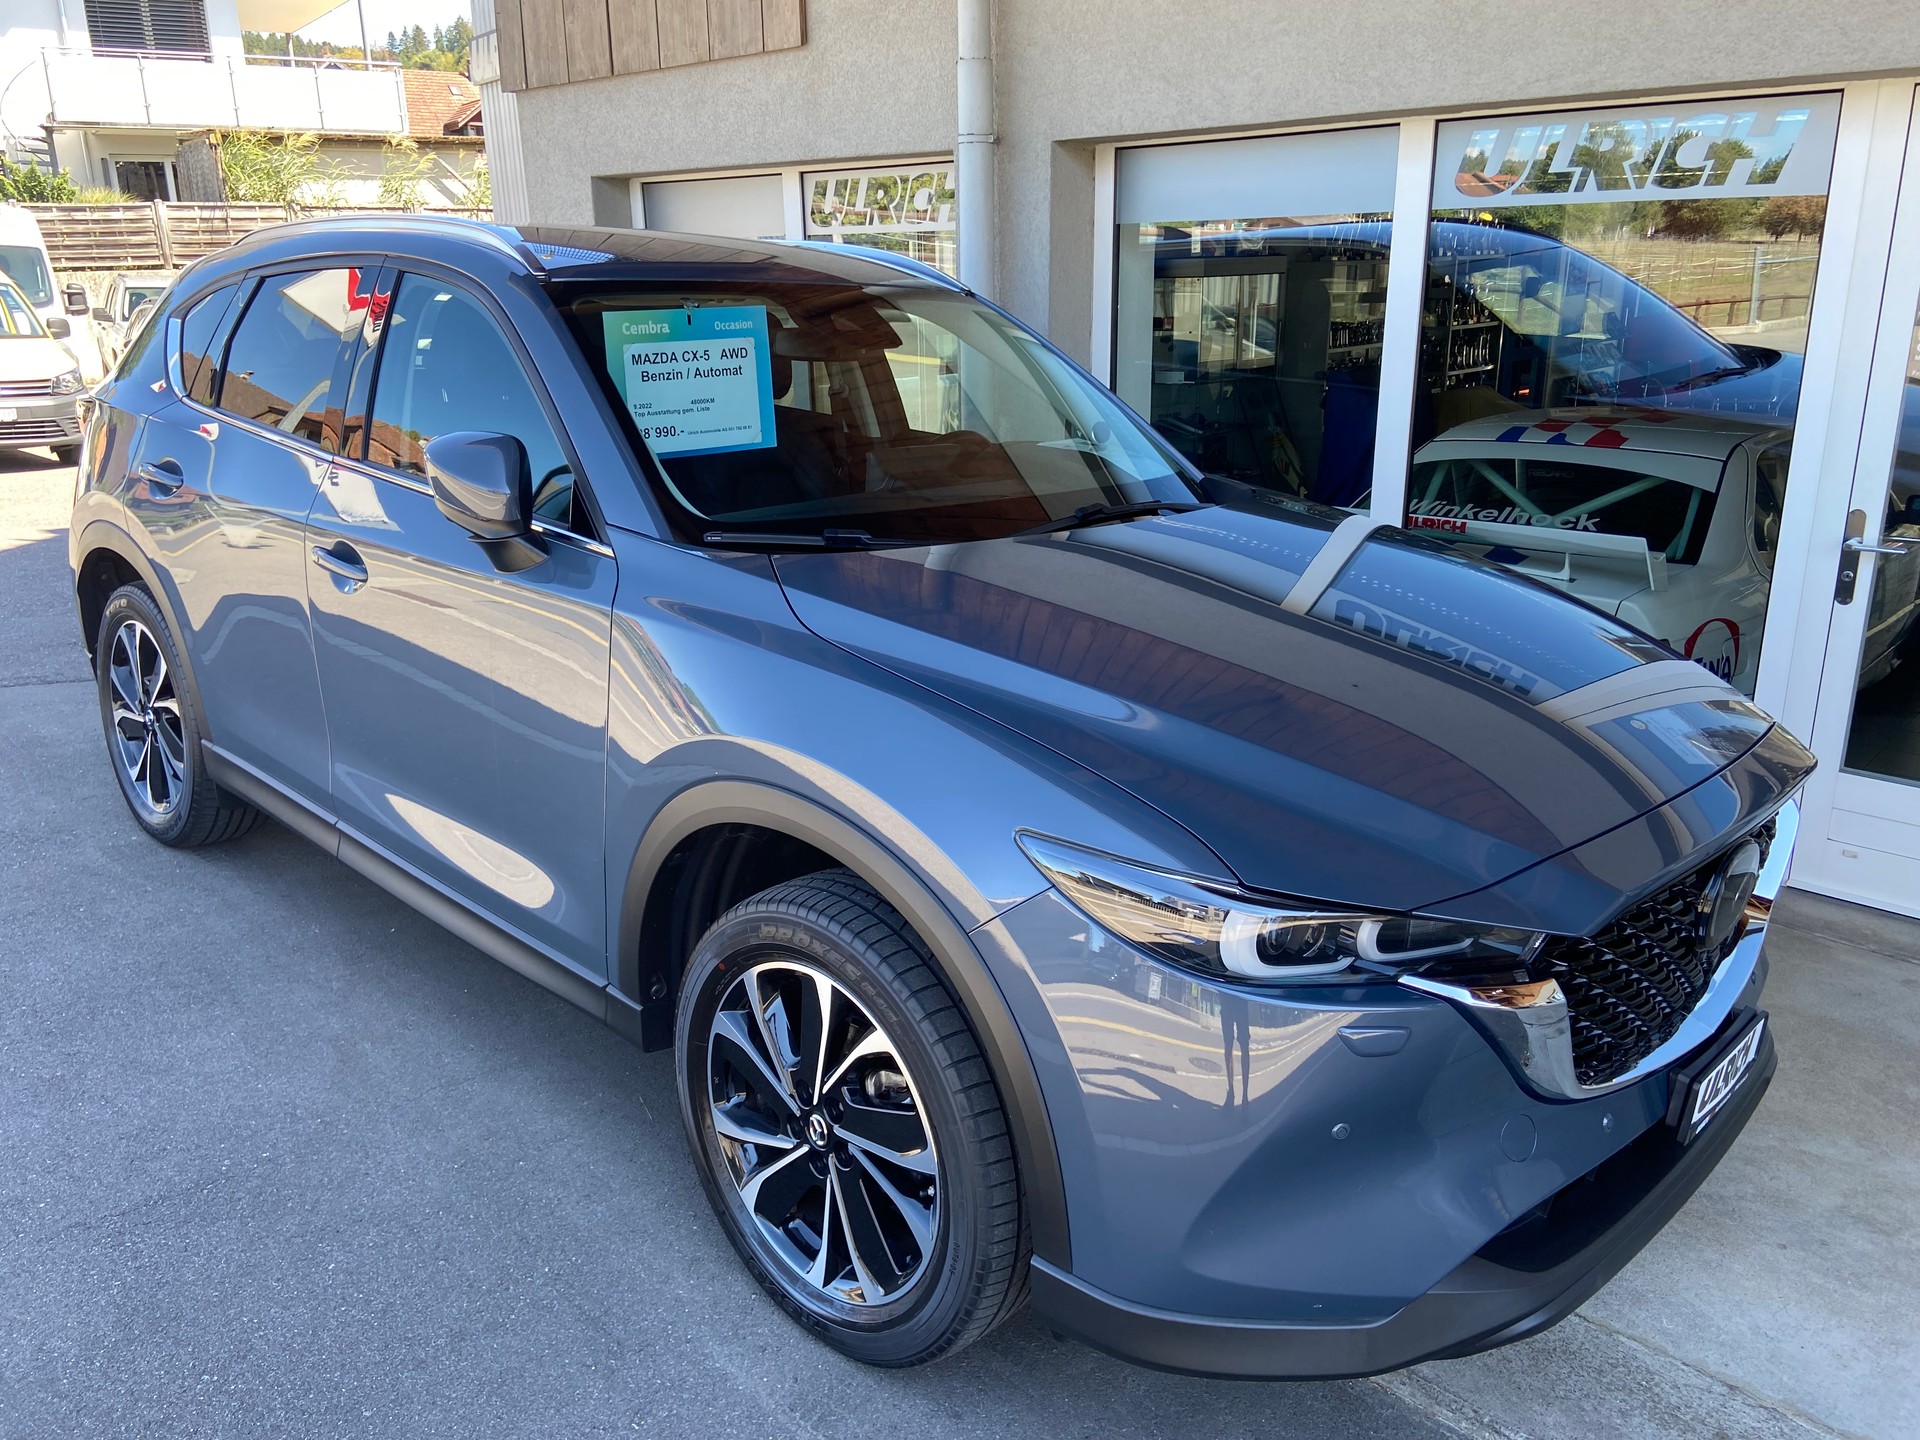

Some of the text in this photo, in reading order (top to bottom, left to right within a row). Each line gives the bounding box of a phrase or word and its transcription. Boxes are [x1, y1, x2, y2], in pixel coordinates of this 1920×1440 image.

[1454, 108, 1811, 198] ULRICH
[622, 321, 670, 335] Cembra
[714, 319, 753, 331] Occasion
[631, 347, 748, 366] MAZDA CX-5 AWD
[641, 364, 743, 383] Benzin / Automat
[696, 405, 711, 413] Liste
[1409, 498, 1601, 532] Winkelhock
[758, 923, 862, 982] PROXES
